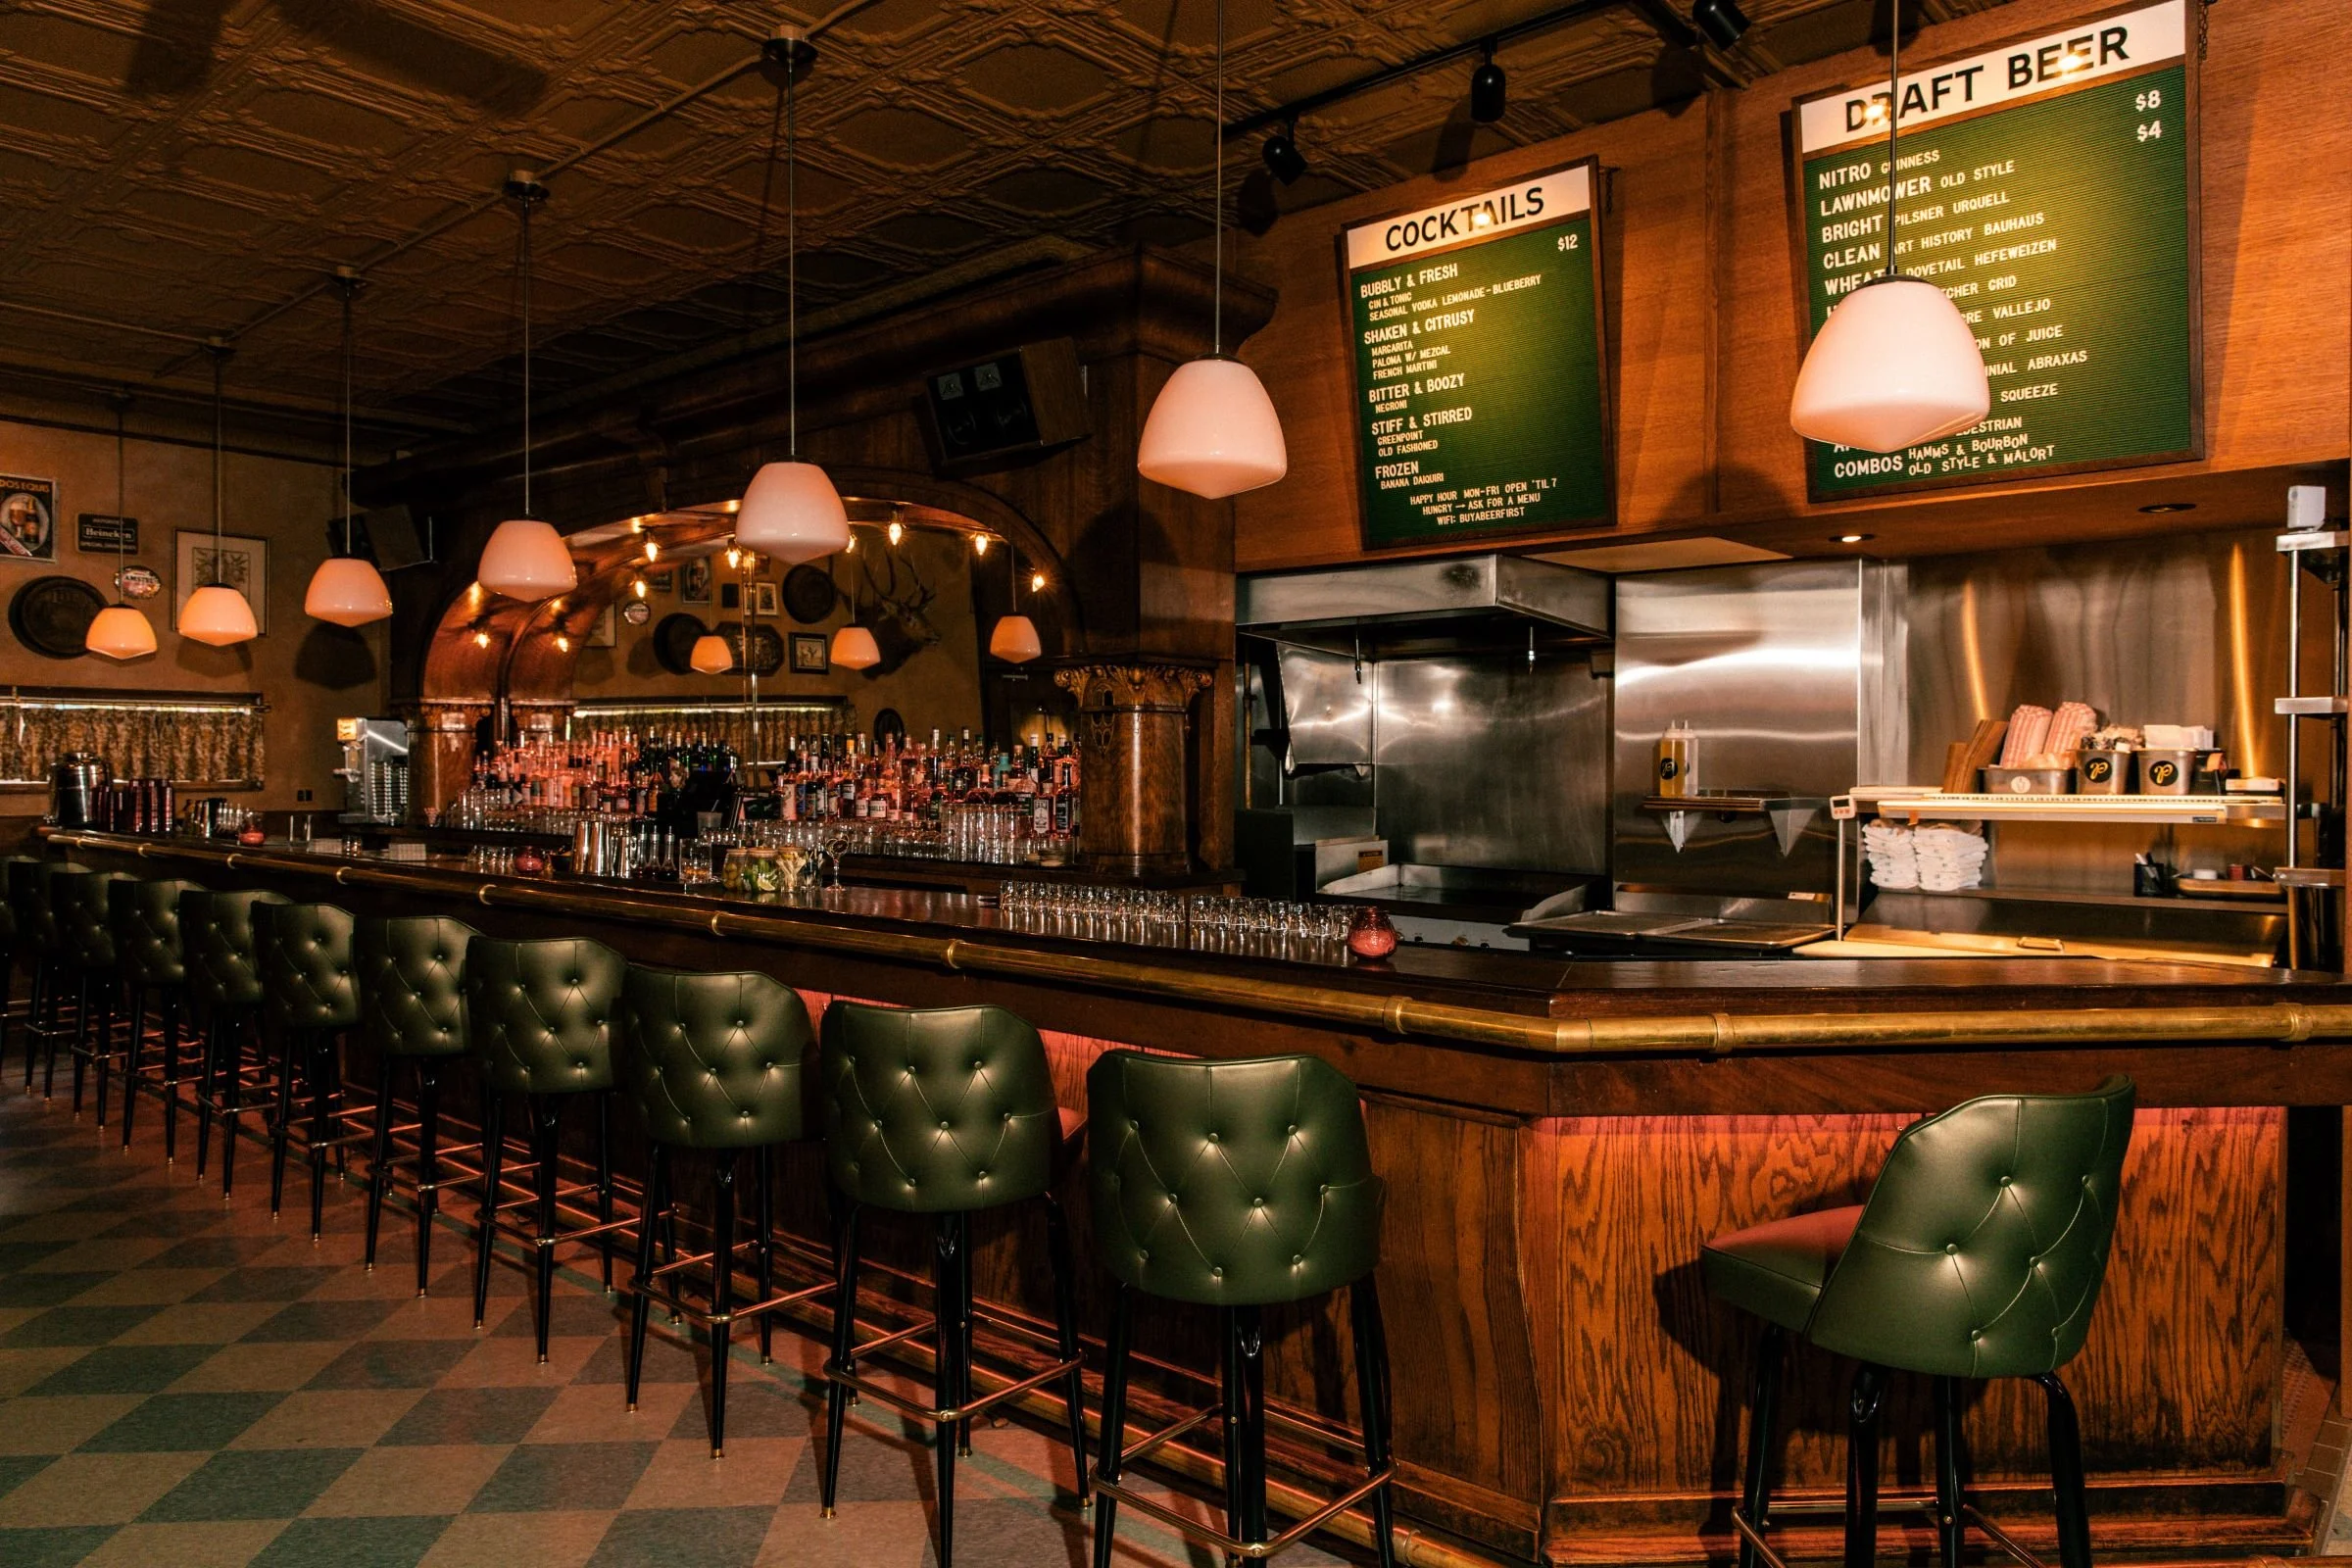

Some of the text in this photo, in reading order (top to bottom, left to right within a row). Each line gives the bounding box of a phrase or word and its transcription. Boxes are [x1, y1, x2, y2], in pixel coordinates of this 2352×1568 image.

[2007, 25, 2130, 90] BEER
[2135, 89, 2160, 112] $8
[2137, 120, 2162, 142] $4
[1819, 162, 1872, 190] NITRO
[1821, 160, 2015, 218] LAWNMOWER OLD STYLE
[1386, 186, 1544, 251] COCKTAILS
[1822, 214, 1884, 243] BRIGHT
[1953, 191, 2010, 215] URQUELL
[1557, 234, 1578, 252] $12
[1823, 242, 1881, 270] CLEAN
[1921, 227, 1973, 250] HISTORY
[1984, 212, 2045, 236] BAUHAUS
[1906, 257, 1966, 277] DOVETAIL
[1975, 238, 2057, 267] HEFEWEIZEN
[1361, 263, 1458, 299] BUBBLY & FRESH
[1988, 274, 2017, 292] GRID
[1368, 292, 1412, 311] GIN & TONIC
[1369, 305, 1407, 321] SEASONAL
[1412, 298, 1438, 313] VODKA
[1993, 298, 2051, 319] VALLEJO
[1364, 309, 1475, 344] SHAKEN & CITRUSY
[1999, 329, 2016, 347] OF
[2026, 324, 2063, 342] JUICE
[1372, 340, 1413, 357] MARGARITA
[1373, 345, 1451, 368] PALOMA W/ MEZCAL
[1373, 360, 1437, 380] FRENCH MARTINI
[2028, 350, 2088, 372] ABRAXAS
[1369, 373, 1465, 404] BITTER & BOOZY
[2000, 383, 2058, 403] SQUEEZE
[1376, 400, 1407, 414] NEGRONI
[1372, 407, 1472, 436] STIFF & STIRRED
[1378, 430, 1423, 446] GREENPOINT
[1378, 440, 1438, 458] OLD FASHIONED
[1908, 433, 2029, 461] HAMMS & BOURBON
[1375, 461, 1419, 479] FROZEN
[1835, 456, 1903, 478] COMBOS
[1908, 445, 2055, 476] OLD STYLE & MALORT
[1381, 472, 1444, 490] BANANA DAIQUIRI
[1410, 493, 1433, 506] HAPPY
[1437, 491, 1457, 502] HOUR
[1464, 486, 1499, 499] MON-FRI
[1505, 482, 1527, 494] OPEN
[1551, 478, 1557, 488] 7
[1423, 493, 1541, 515] HUNGRY ASK FOR A MENU
[1438, 507, 1525, 526] WIFI: BUYABEERFIRST
